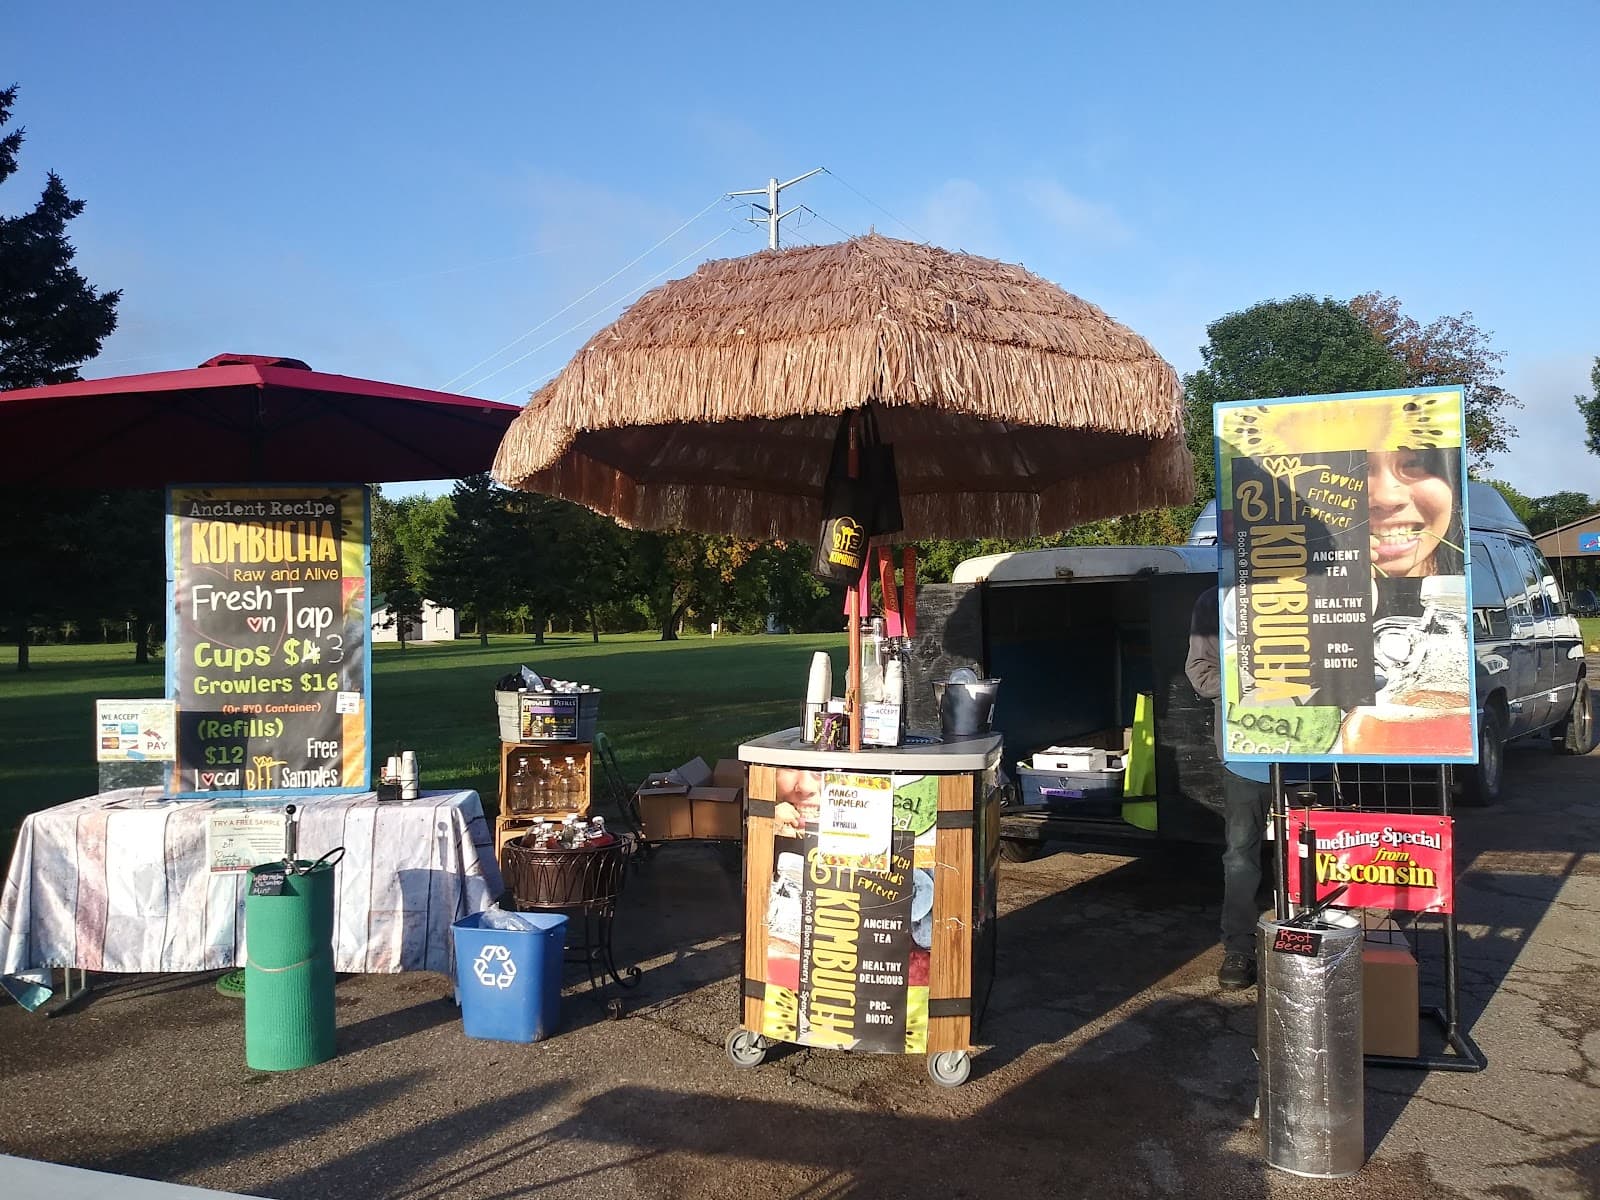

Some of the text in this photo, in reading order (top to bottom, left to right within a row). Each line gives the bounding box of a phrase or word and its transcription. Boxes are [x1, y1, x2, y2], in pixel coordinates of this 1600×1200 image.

[191, 501, 336, 516] Ancient Recipe
[191, 521, 338, 564] KOMBUCHA
[1237, 531, 1248, 558] Booch
[1313, 550, 1360, 562] ANCIENT
[1238, 559, 1248, 568] @
[234, 568, 339, 581] Raw and Alive
[1326, 566, 1348, 577] TEA
[1238, 570, 1249, 596] Bloom
[191, 584, 273, 620] Fresh
[1315, 597, 1363, 610] HEALTHY
[274, 587, 334, 638] Tap
[1238, 597, 1250, 636] Brewery
[1249, 524, 1312, 702] KOMBUCHA
[1312, 613, 1367, 624] DELICIOUS
[1327, 643, 1354, 654] PRO-
[193, 642, 271, 673] Cups
[1324, 658, 1358, 669] BIOTIC
[193, 672, 339, 695] Growlers $16
[243, 704, 263, 713] BYO
[265, 702, 322, 714] Container)
[198, 717, 285, 739] (Refills)
[147, 742, 167, 750] PAY
[307, 737, 339, 759] Free
[205, 746, 244, 765] $12
[282, 766, 338, 789] Samples
[828, 789, 858, 798] MANGO
[828, 798, 870, 808] TURMERIC
[1316, 827, 1442, 850] mething Special
[1371, 847, 1410, 863] from
[804, 890, 814, 914] Booch
[804, 915, 812, 923] @
[864, 918, 903, 930] ANCIENT
[803, 925, 812, 948] Bloom
[873, 933, 892, 944] TEA
[1278, 929, 1314, 943] Root
[800, 949, 810, 983] Brewery
[809, 888, 861, 1043] KOMBUCHA
[862, 960, 901, 972] HEALTHY
[859, 973, 904, 986] DELICIOUS
[869, 1001, 891, 1011] PRO-
[866, 1013, 894, 1025] BIOTIC
